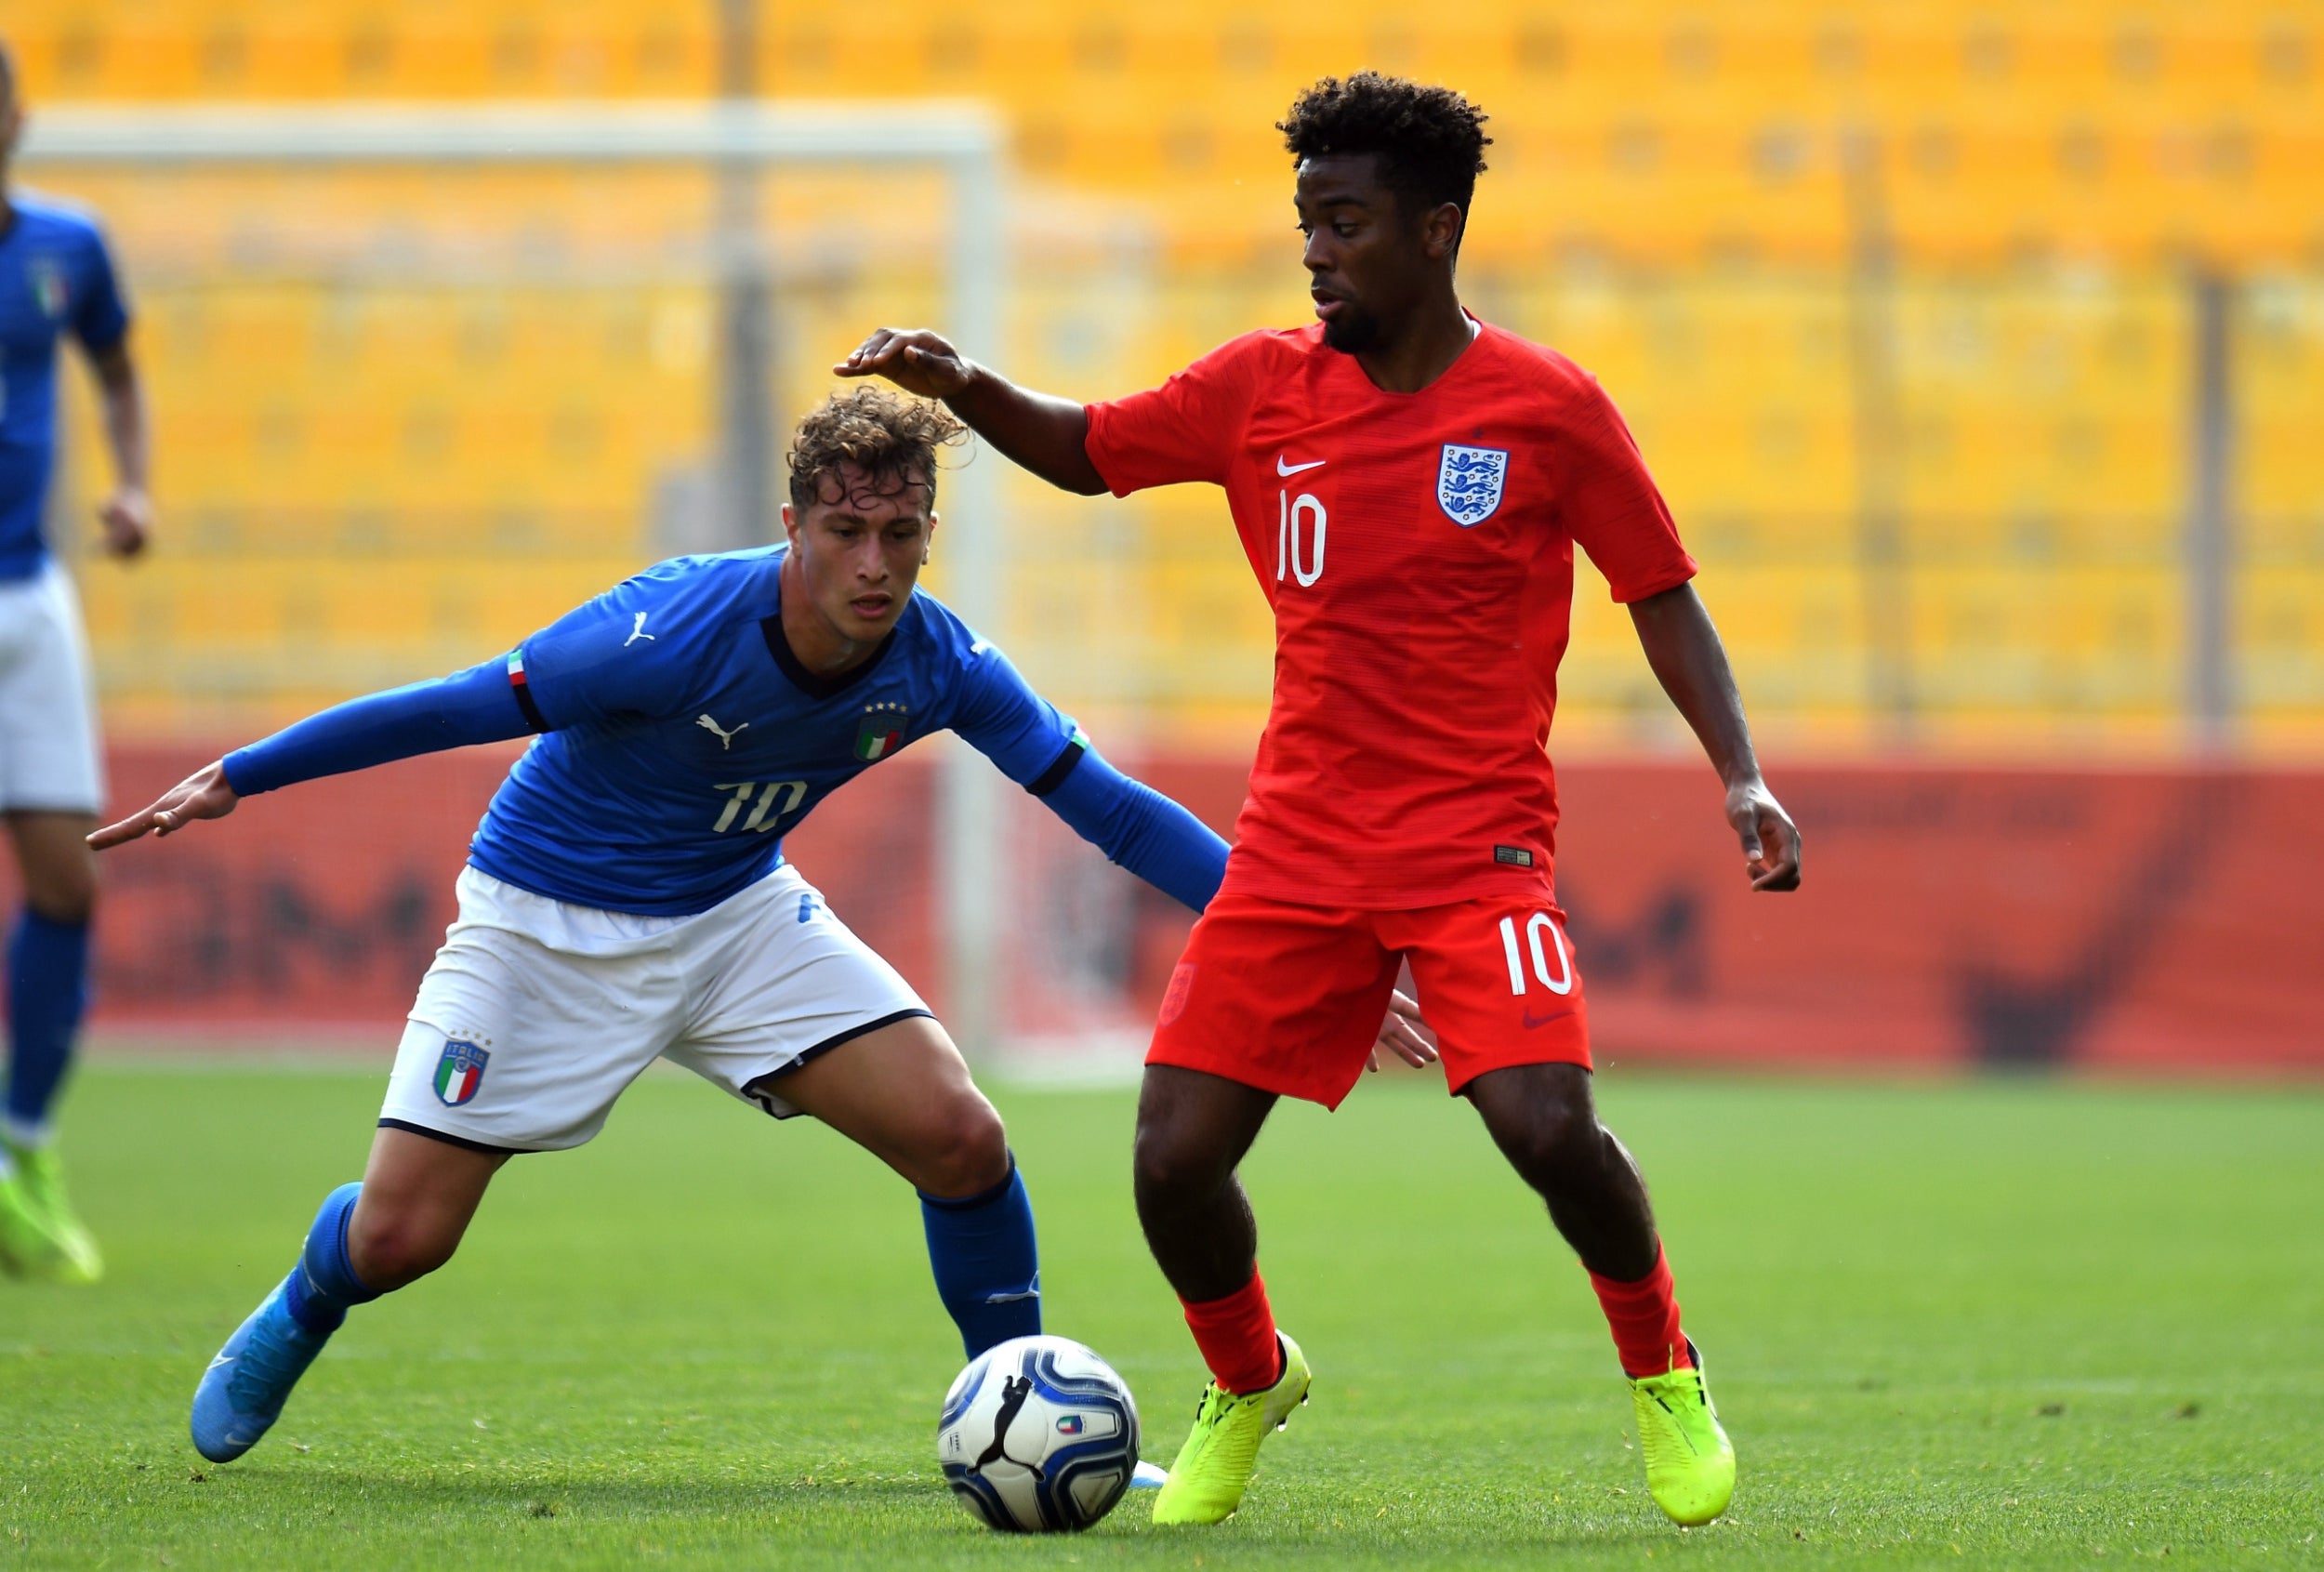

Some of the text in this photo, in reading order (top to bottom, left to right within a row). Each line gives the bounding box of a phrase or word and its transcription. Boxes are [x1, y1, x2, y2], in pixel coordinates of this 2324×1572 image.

[1276, 489, 1327, 588] 10
[713, 780, 808, 833] 10
[1499, 912, 1572, 996] 10
